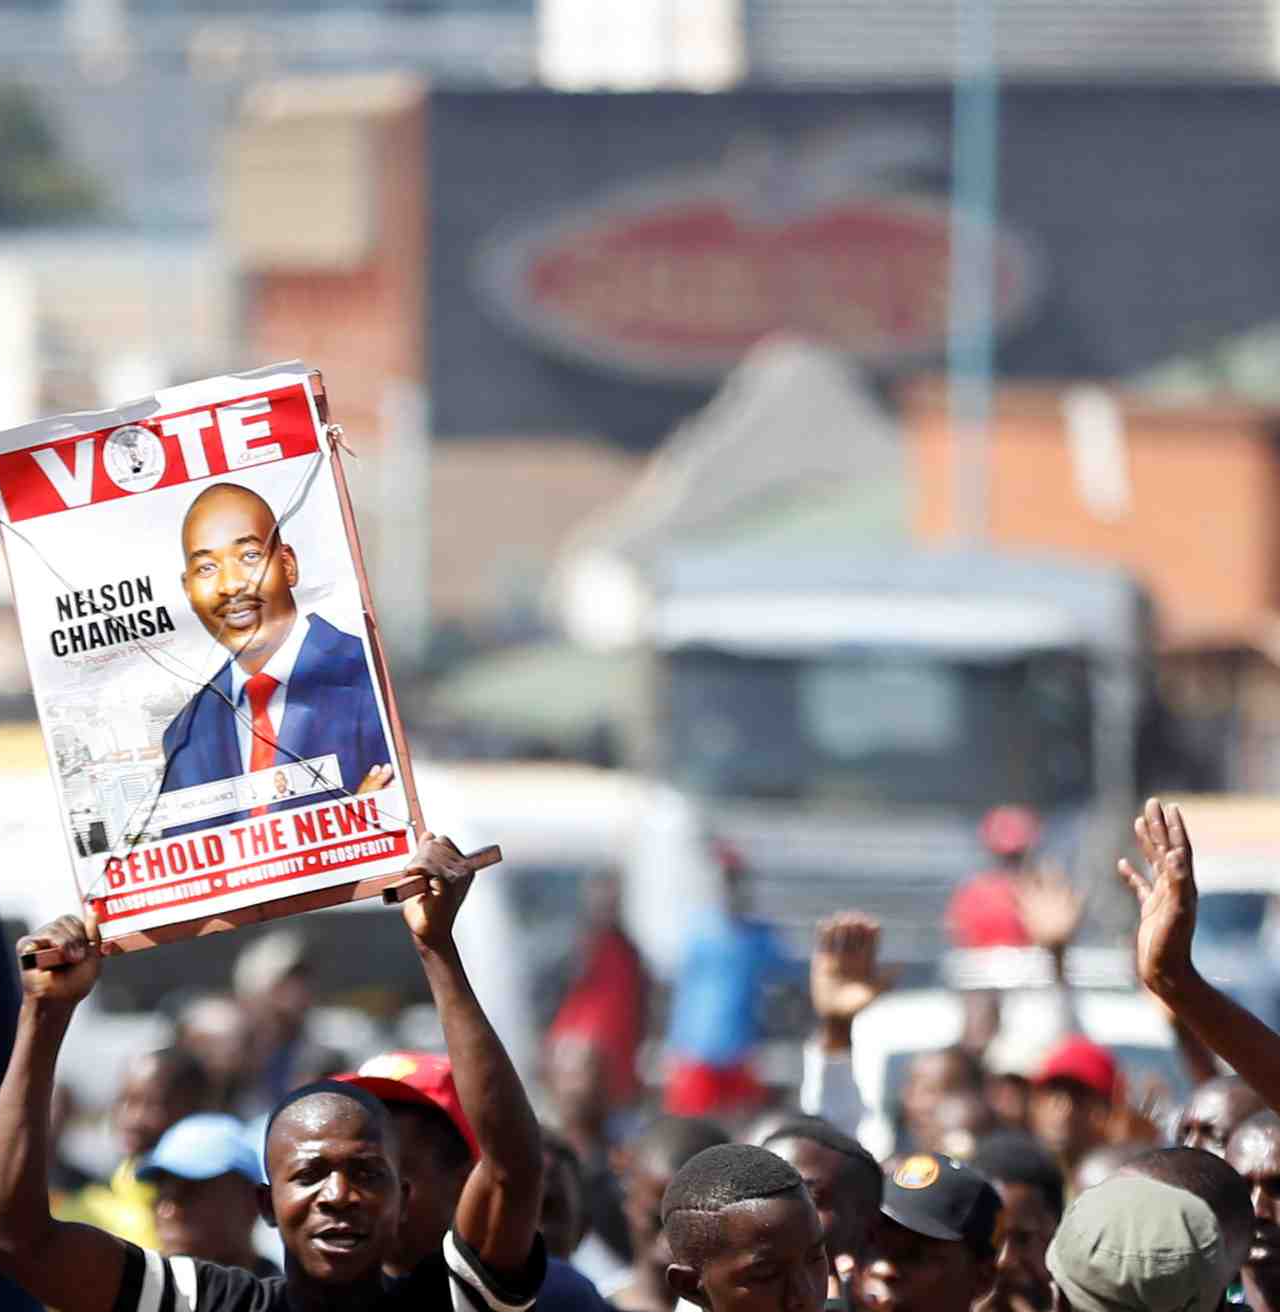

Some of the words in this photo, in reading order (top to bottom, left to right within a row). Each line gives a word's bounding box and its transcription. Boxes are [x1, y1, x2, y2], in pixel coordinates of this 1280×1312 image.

[30, 396, 284, 510] VOTE
[56, 576, 154, 622] NELSON
[50, 606, 176, 657] CHAMISA
[105, 834, 225, 889] BEHOLD
[230, 818, 287, 860] THE
[293, 797, 379, 847] NEW!
[320, 837, 395, 866] PROSPERITY
